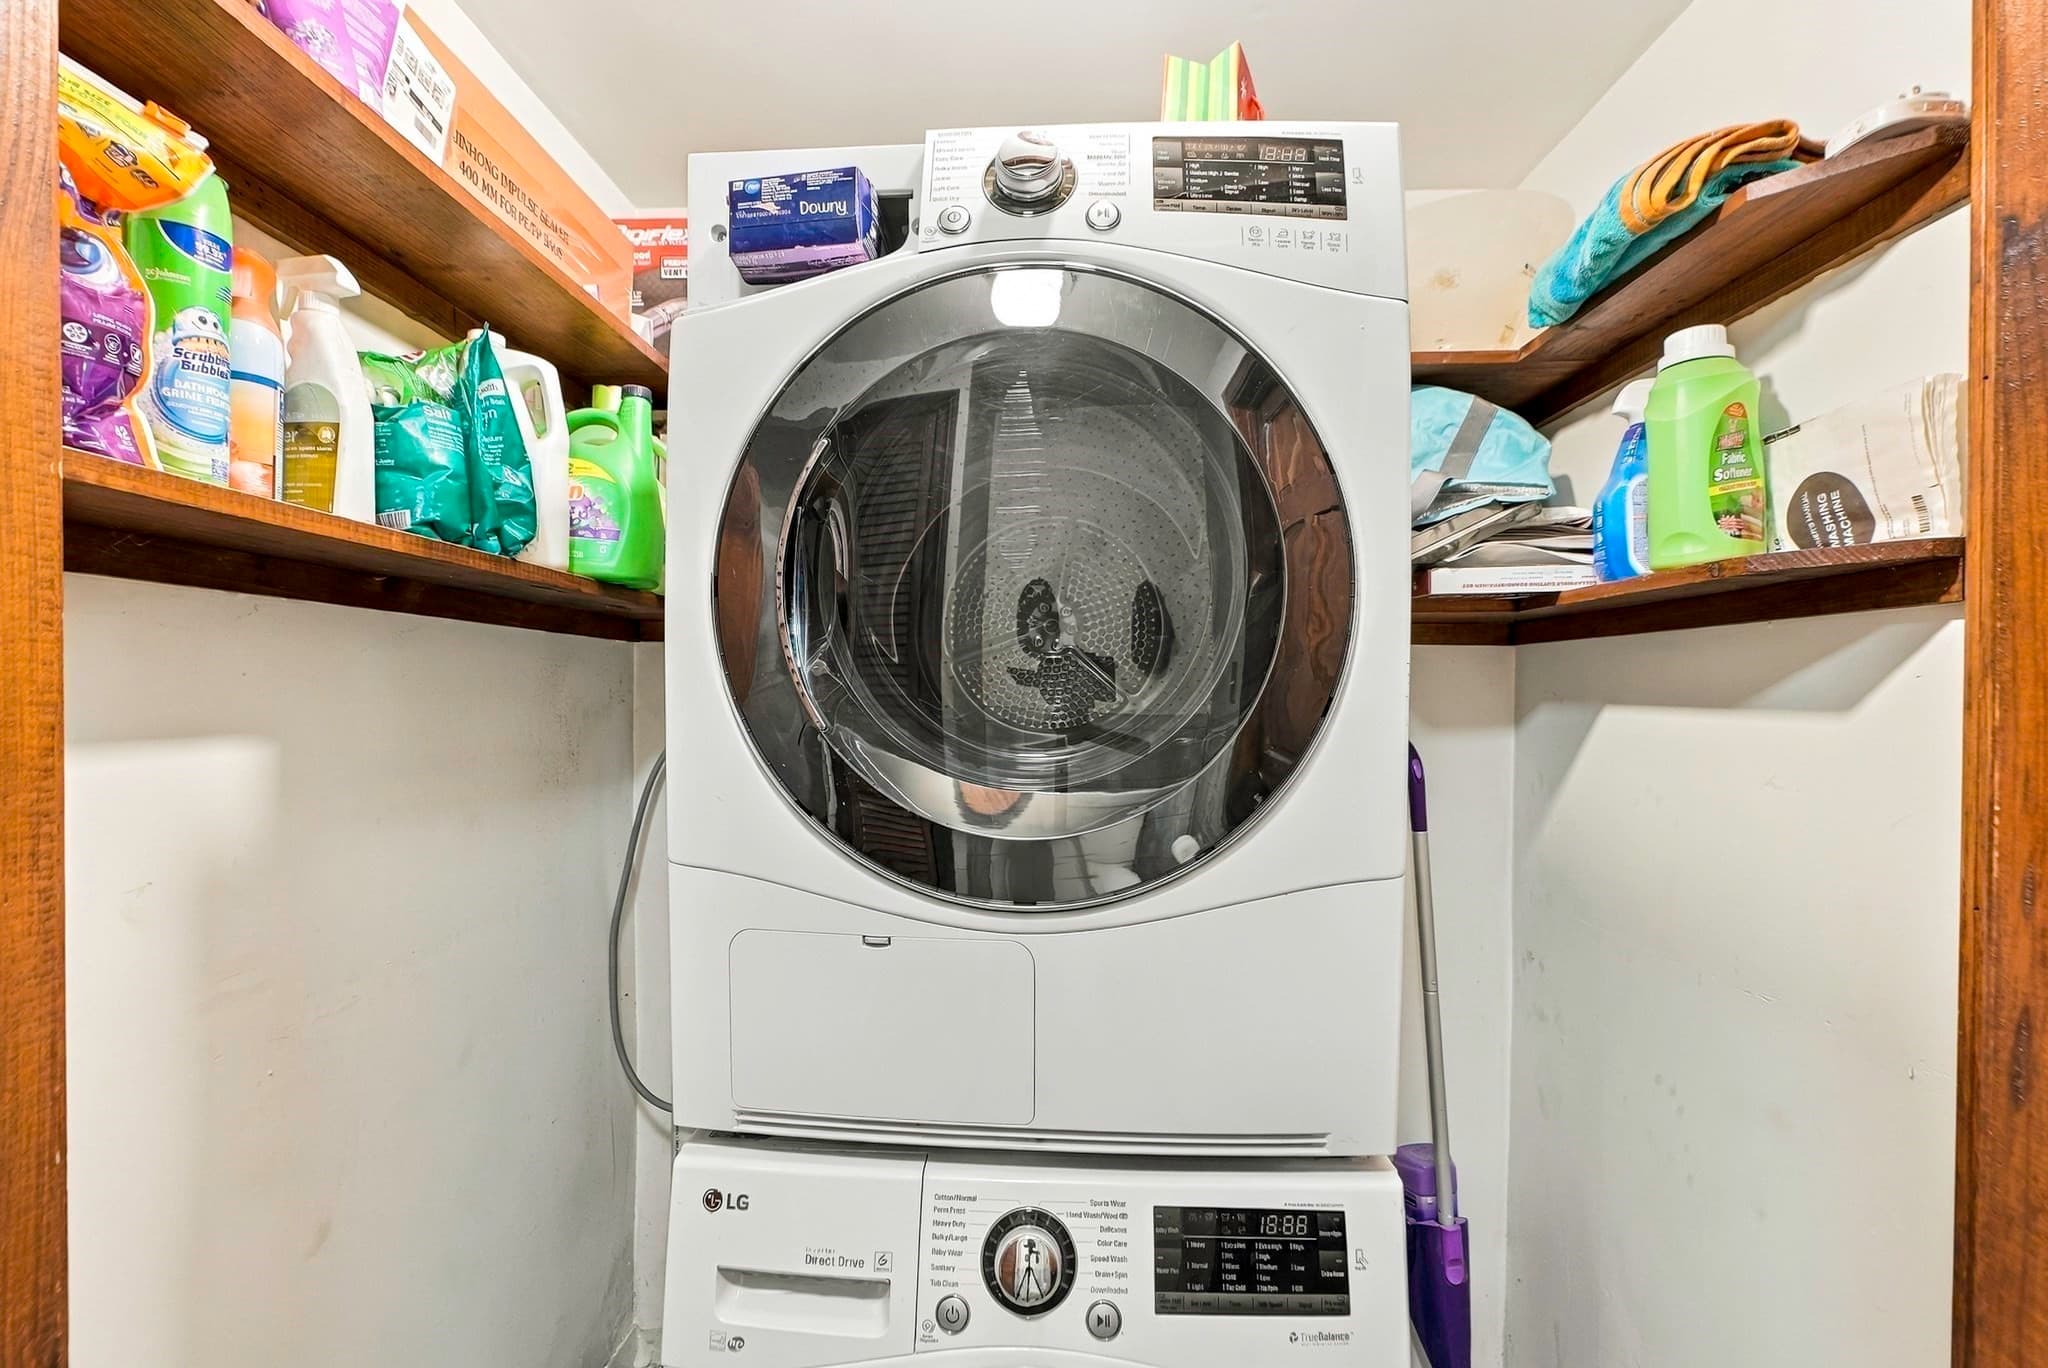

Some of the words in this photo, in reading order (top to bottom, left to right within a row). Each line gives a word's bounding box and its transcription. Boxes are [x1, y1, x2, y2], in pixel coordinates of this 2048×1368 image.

[454, 129, 499, 180] JINHONG
[501, 172, 539, 217] IMPULSE
[459, 160, 479, 187] 400
[481, 178, 498, 205] MM
[500, 194, 518, 221] FOR
[799, 200, 849, 216] Downy
[1722, 451, 1746, 465] Fabric
[1713, 467, 1753, 482] Softener
[726, 1192, 750, 1212] LG
[1259, 1214, 1308, 1236] 18:88
[805, 1253, 835, 1267] Direct
[837, 1255, 865, 1269] Drive
